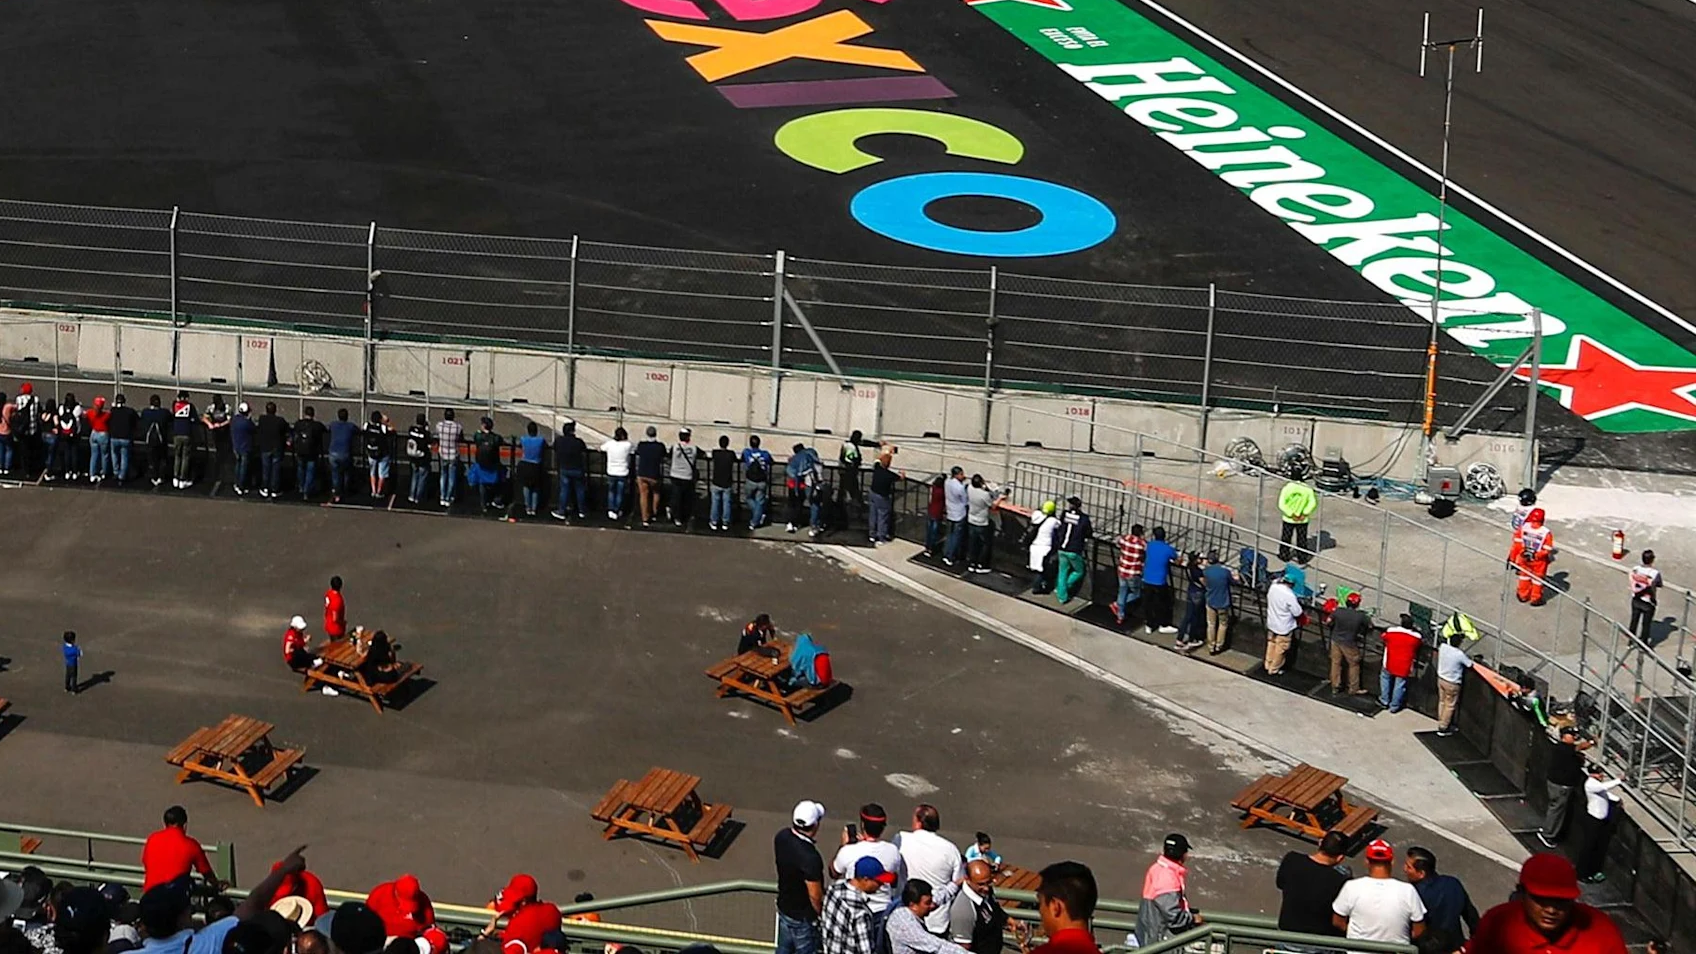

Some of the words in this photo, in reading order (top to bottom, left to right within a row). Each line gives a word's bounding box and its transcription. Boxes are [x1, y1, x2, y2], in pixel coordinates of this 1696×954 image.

[1058, 56, 1566, 348] Heineken
[442, 357, 464, 366] 1021
[646, 372, 669, 381] 1020
[1065, 407, 1089, 416] 1018
[1489, 443, 1515, 452] 1016
